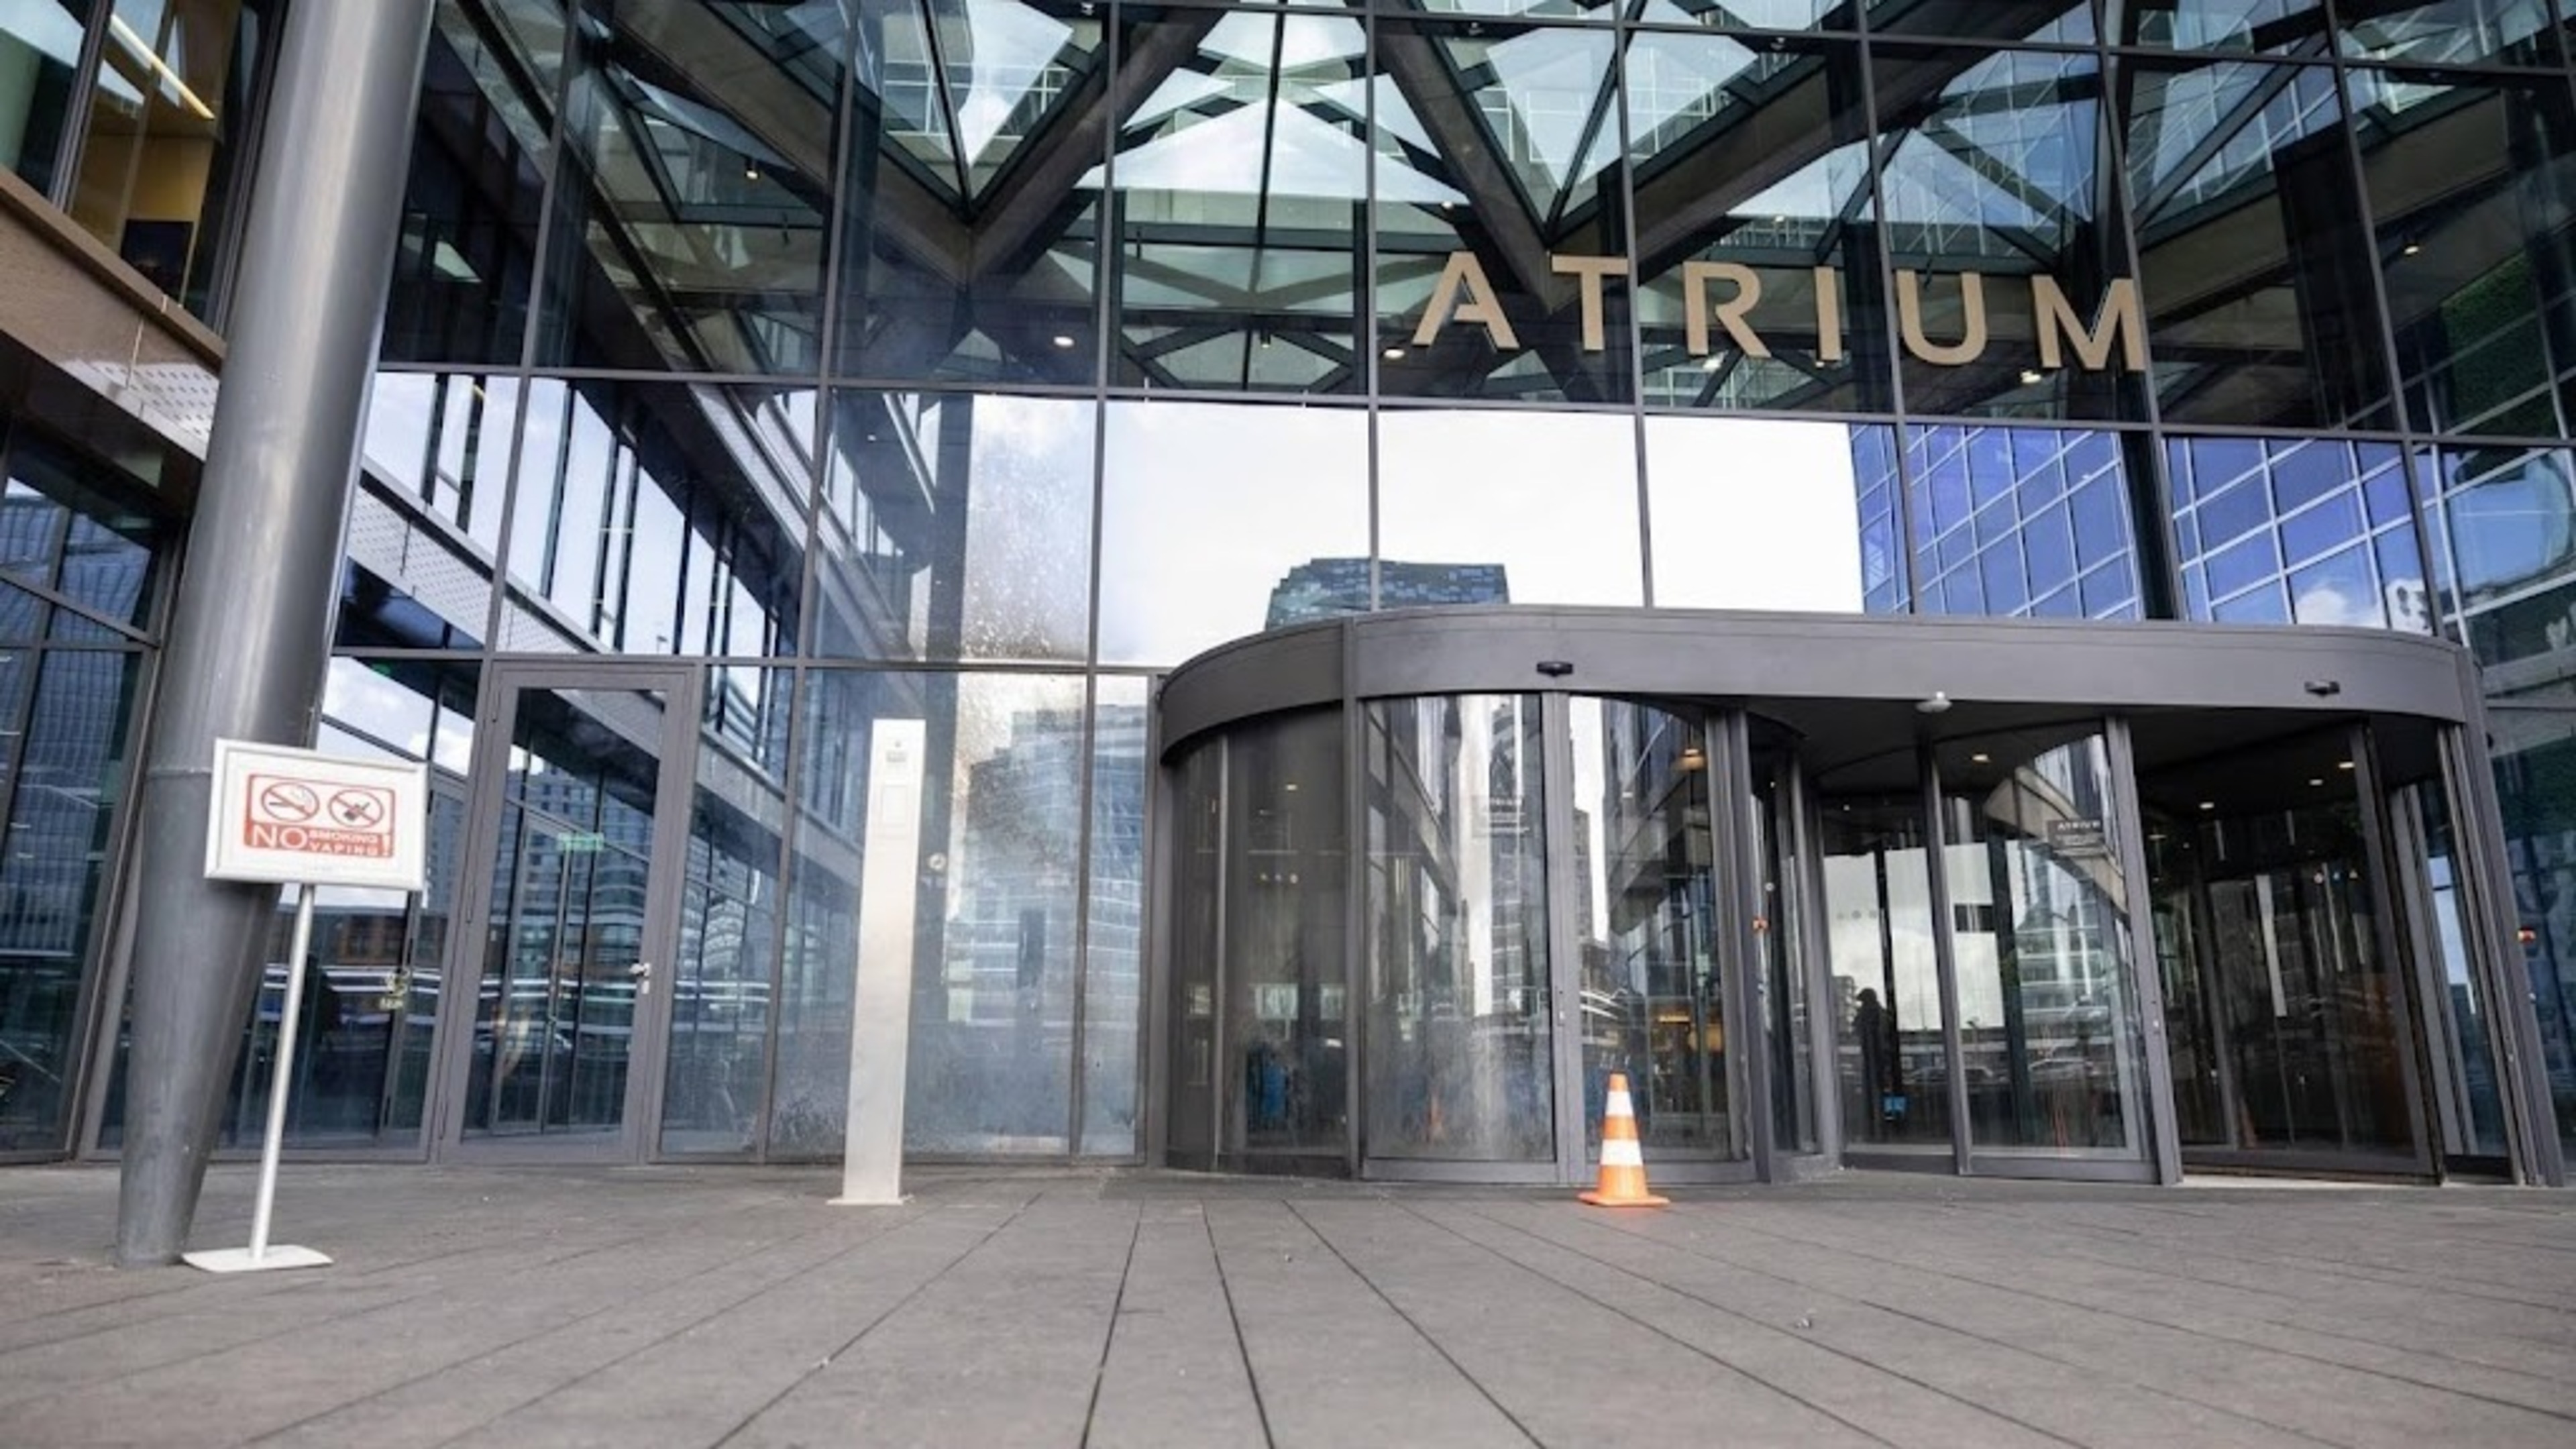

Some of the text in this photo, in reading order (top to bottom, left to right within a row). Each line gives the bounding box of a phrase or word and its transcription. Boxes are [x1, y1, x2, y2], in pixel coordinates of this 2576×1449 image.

[1411, 250, 2147, 372] ATRIUM
[252, 824, 378, 849] NO SMOKING
[309, 843, 378, 856] VAPING
